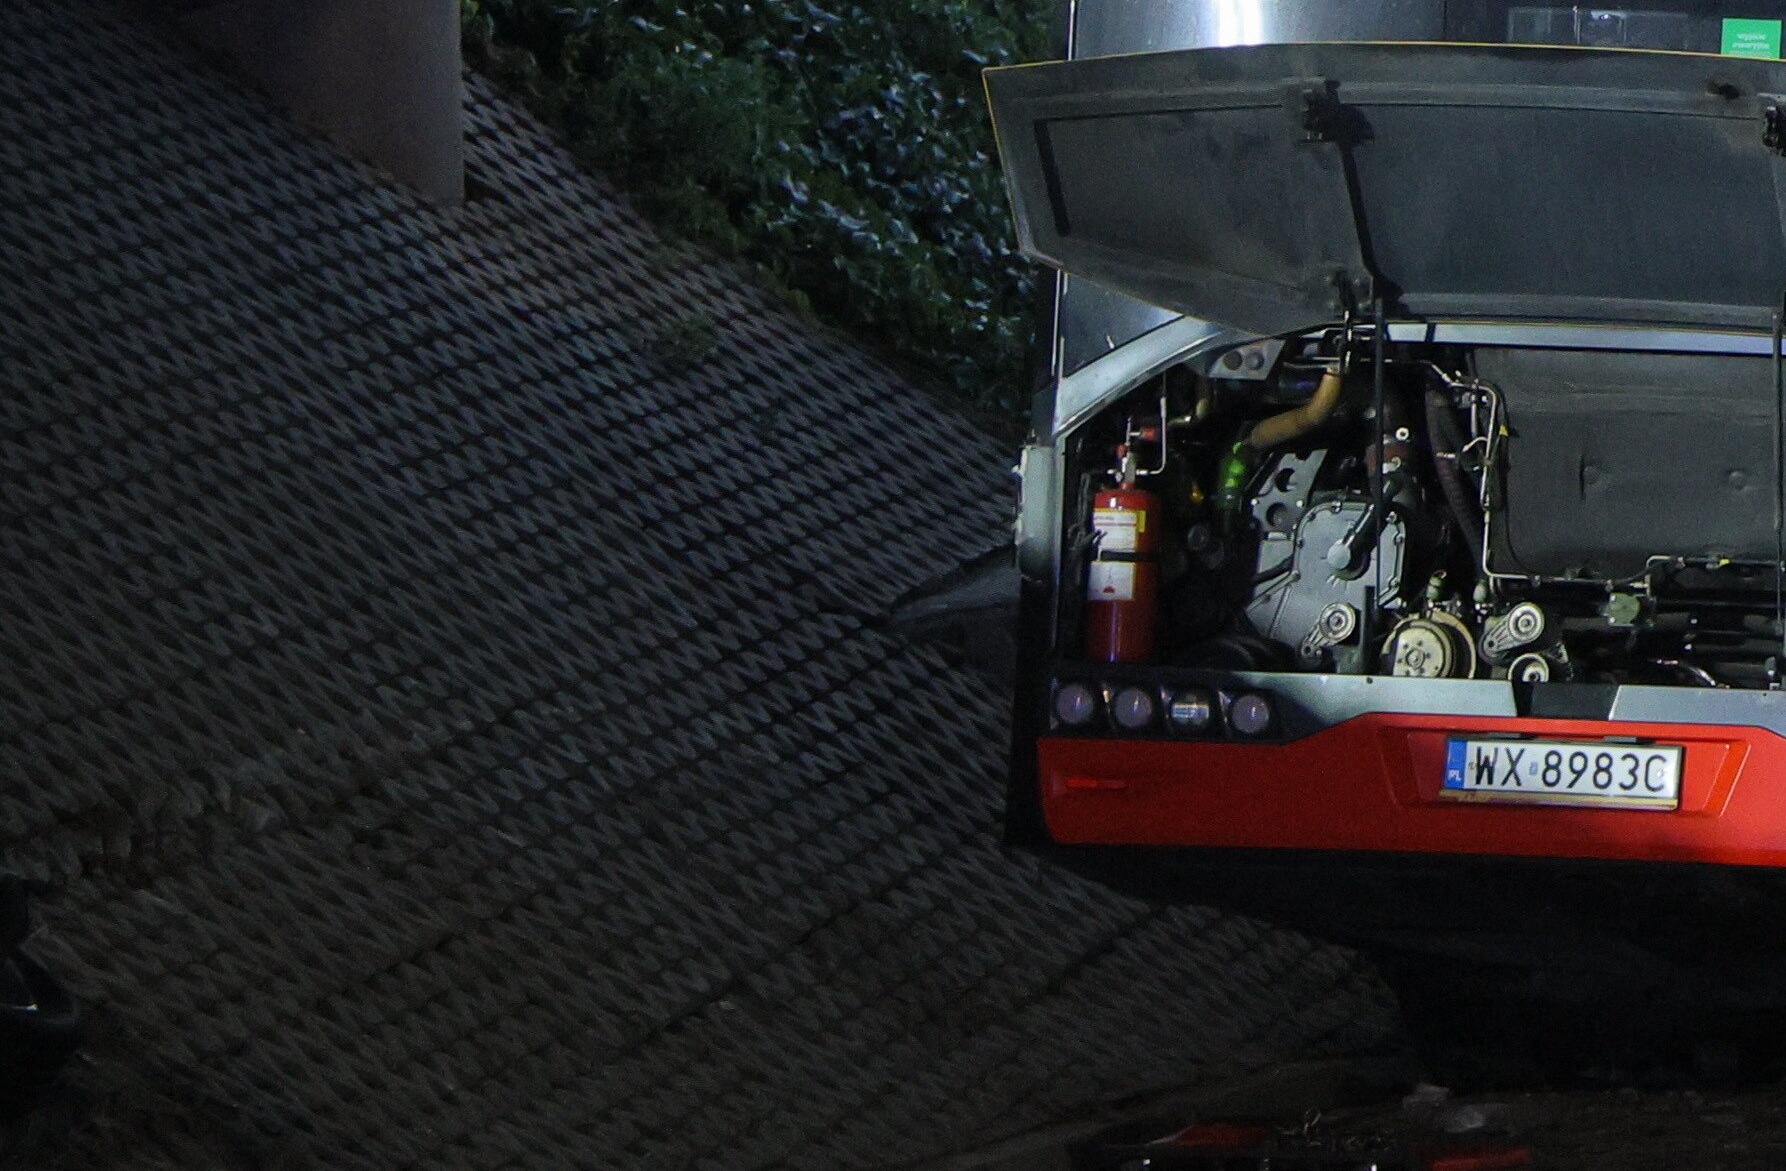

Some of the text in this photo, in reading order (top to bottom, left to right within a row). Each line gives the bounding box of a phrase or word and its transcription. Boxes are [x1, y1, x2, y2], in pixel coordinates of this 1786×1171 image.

[1449, 769, 1462, 782] PL
[1475, 746, 1668, 793] WX 8983C
